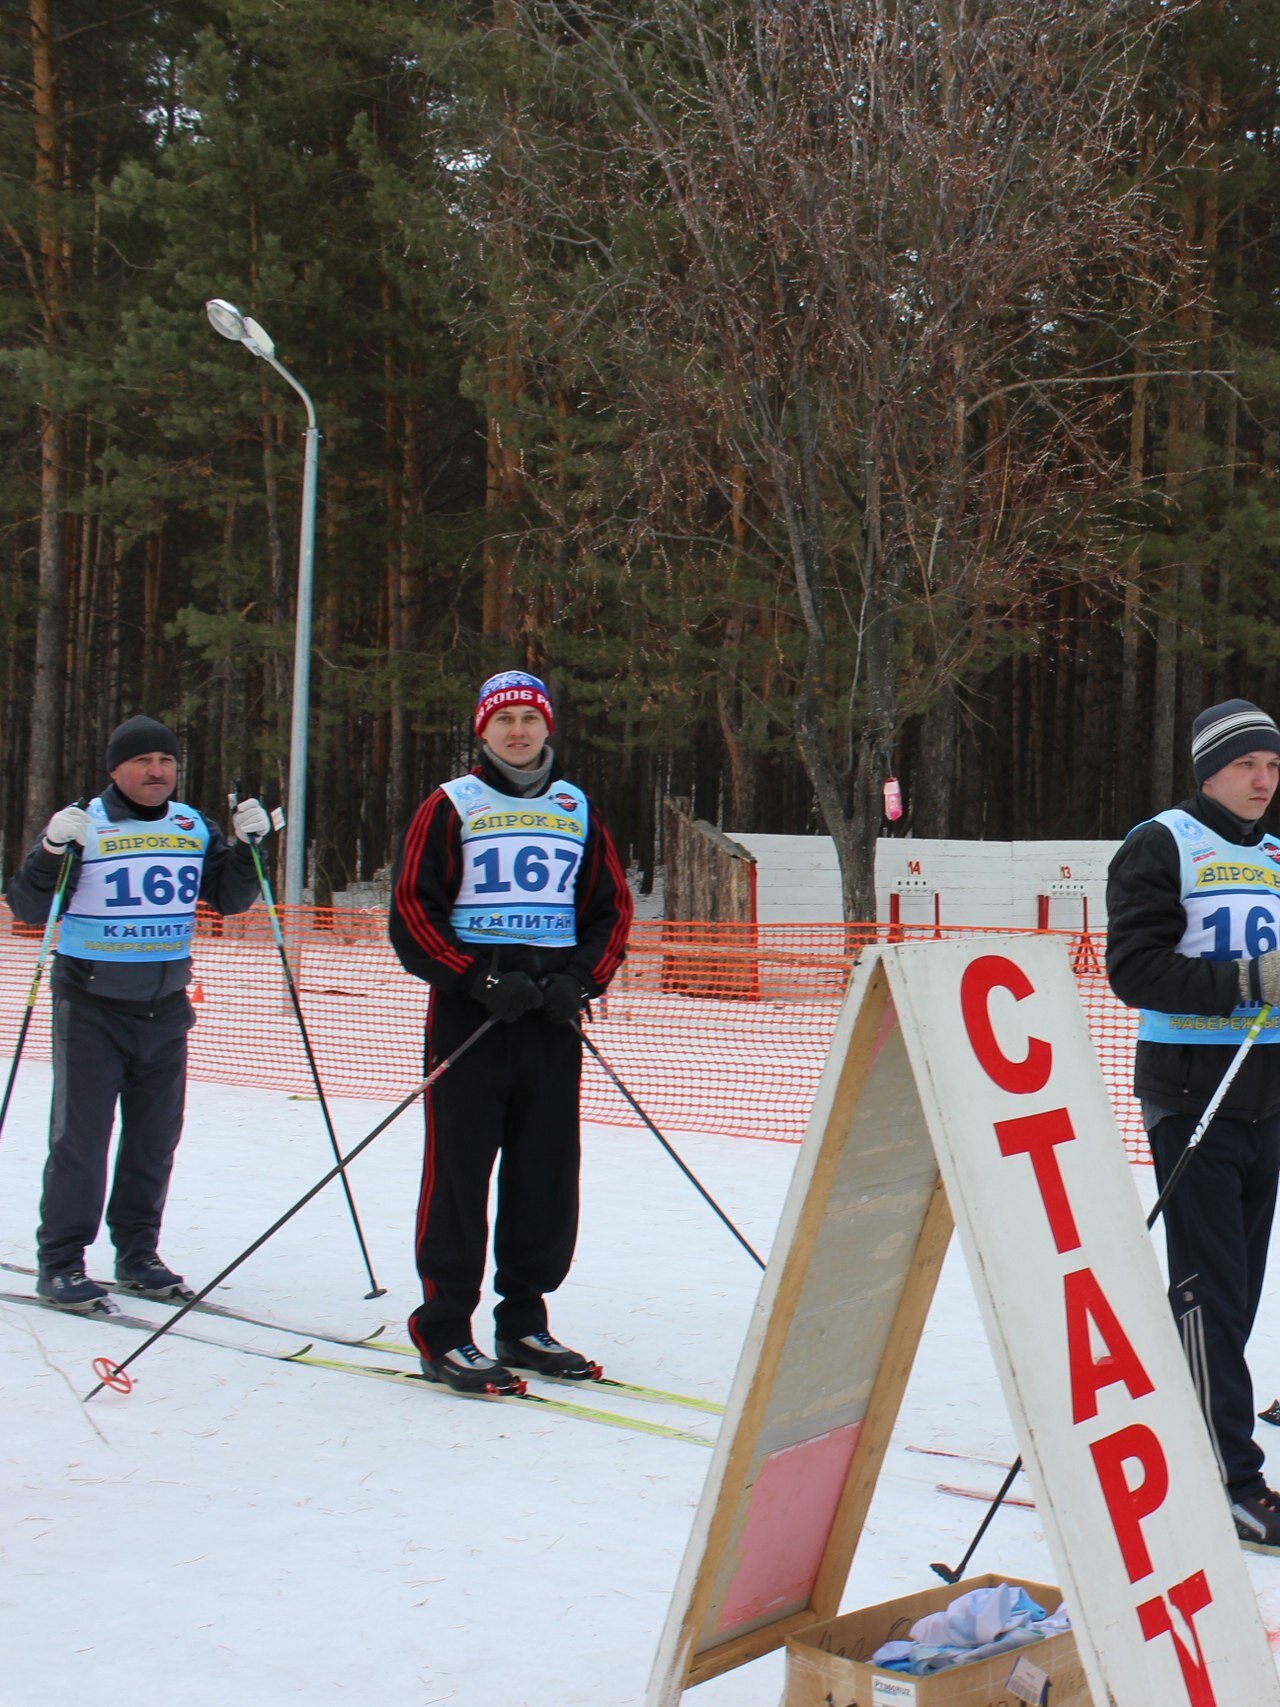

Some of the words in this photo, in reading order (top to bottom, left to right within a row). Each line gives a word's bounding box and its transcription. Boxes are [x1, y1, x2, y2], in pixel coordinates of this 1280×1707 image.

[485, 690, 534, 711] 2006
[471, 814, 581, 834] ВПРОК.РФ
[473, 846, 579, 894] 167
[908, 861, 921, 875] 14
[1060, 866, 1072, 879] 13
[104, 865, 200, 908] 168
[468, 912, 572, 930] КАПИТАН
[959, 955, 1217, 1707] СТАРТ
